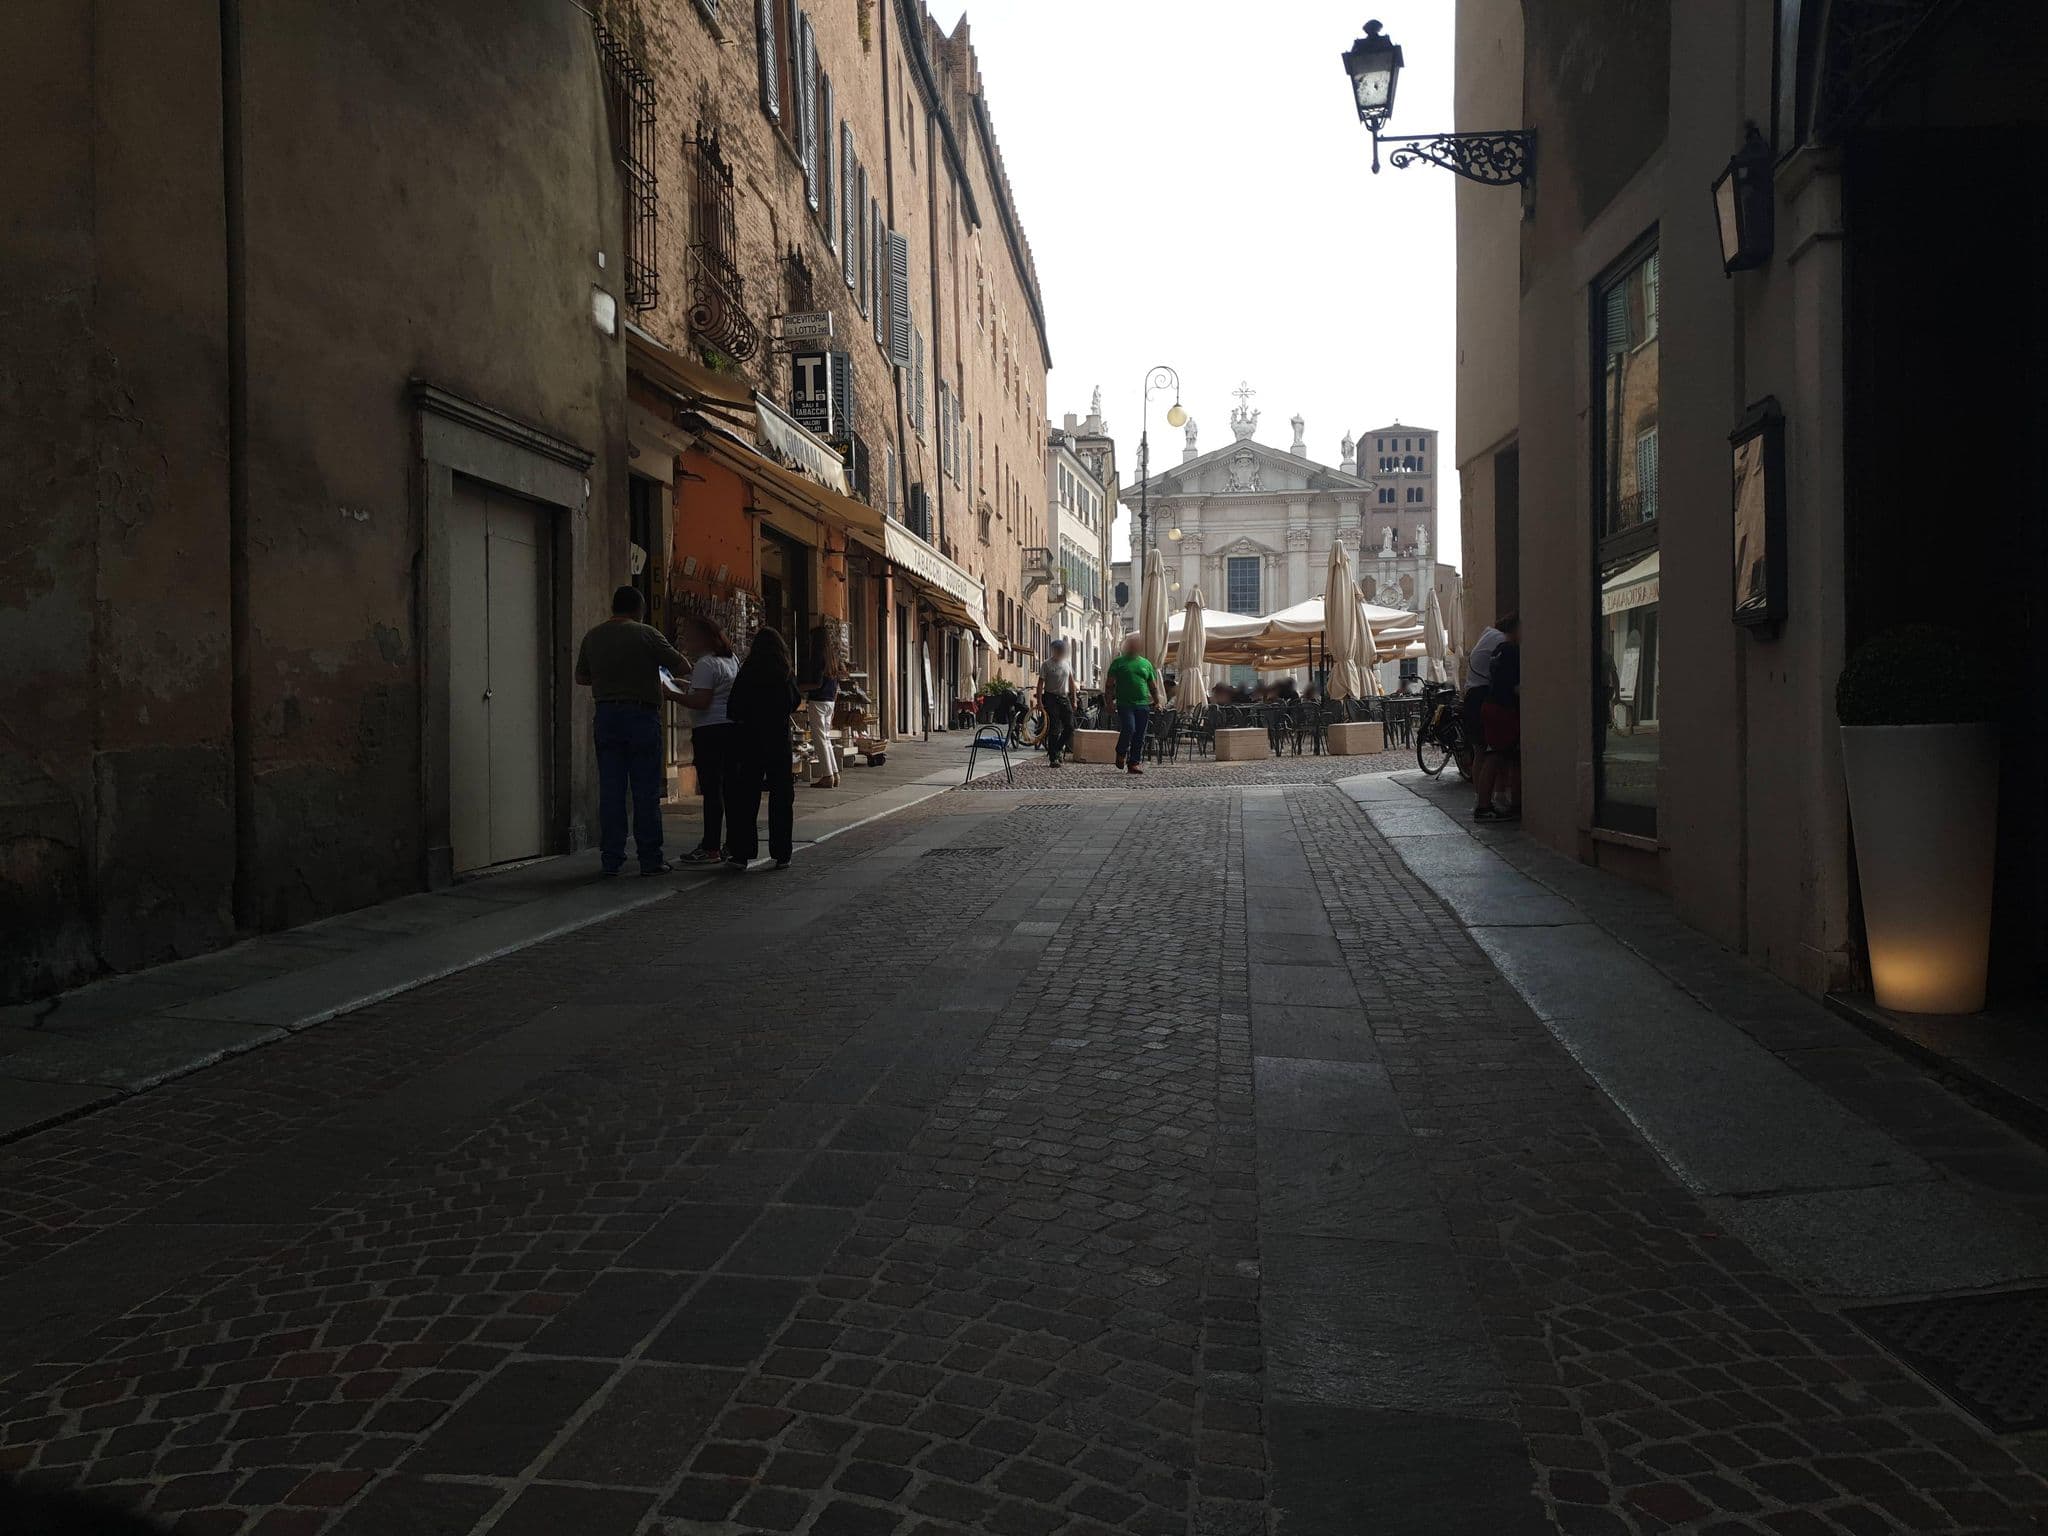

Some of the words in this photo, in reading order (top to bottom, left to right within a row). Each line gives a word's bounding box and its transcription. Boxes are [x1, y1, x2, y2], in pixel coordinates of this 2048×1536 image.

[785, 314, 826, 324] RICEVITORIA
[795, 326, 817, 335] LOTTO
[797, 357, 822, 401] T
[795, 408, 827, 416] TABACCHI
[785, 429, 822, 474] GIORNALI
[914, 549, 942, 582] TABACCHI
